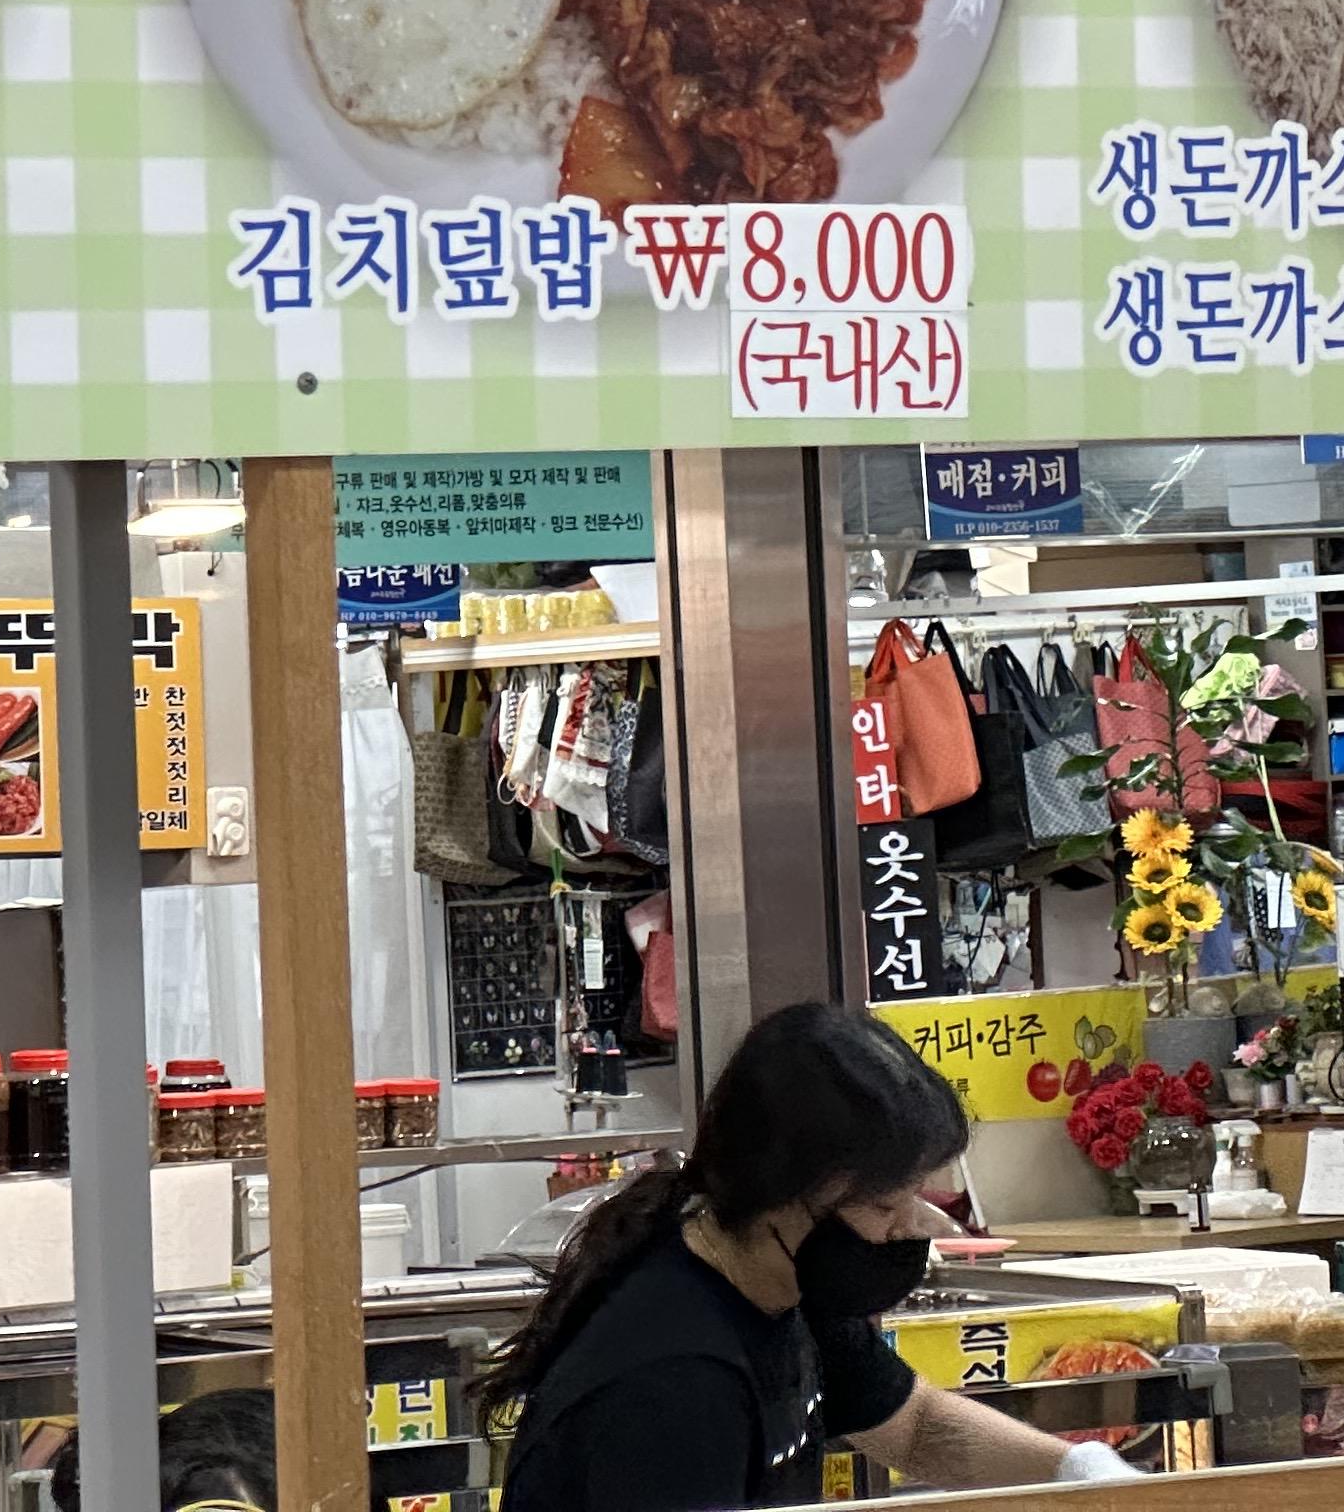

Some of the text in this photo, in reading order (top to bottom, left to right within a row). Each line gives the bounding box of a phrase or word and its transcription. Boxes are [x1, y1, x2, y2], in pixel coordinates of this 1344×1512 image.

[237, 205, 608, 314] 김치덮밥
[738, 314, 964, 414] (국내산)
[370, 471, 397, 488] 판매
[403, 470, 417, 488] 및
[490, 468, 503, 487] 및
[509, 468, 536, 486] 모자
[542, 467, 570, 485] 제작
[575, 466, 588, 484] 및
[594, 466, 621, 484] 판매
[381, 518, 450, 538] 영유아동복
[466, 517, 536, 535] 앞치마제작
[865, 830, 928, 991] 옷수선
[914, 1013, 1047, 1063] 커피·감주
